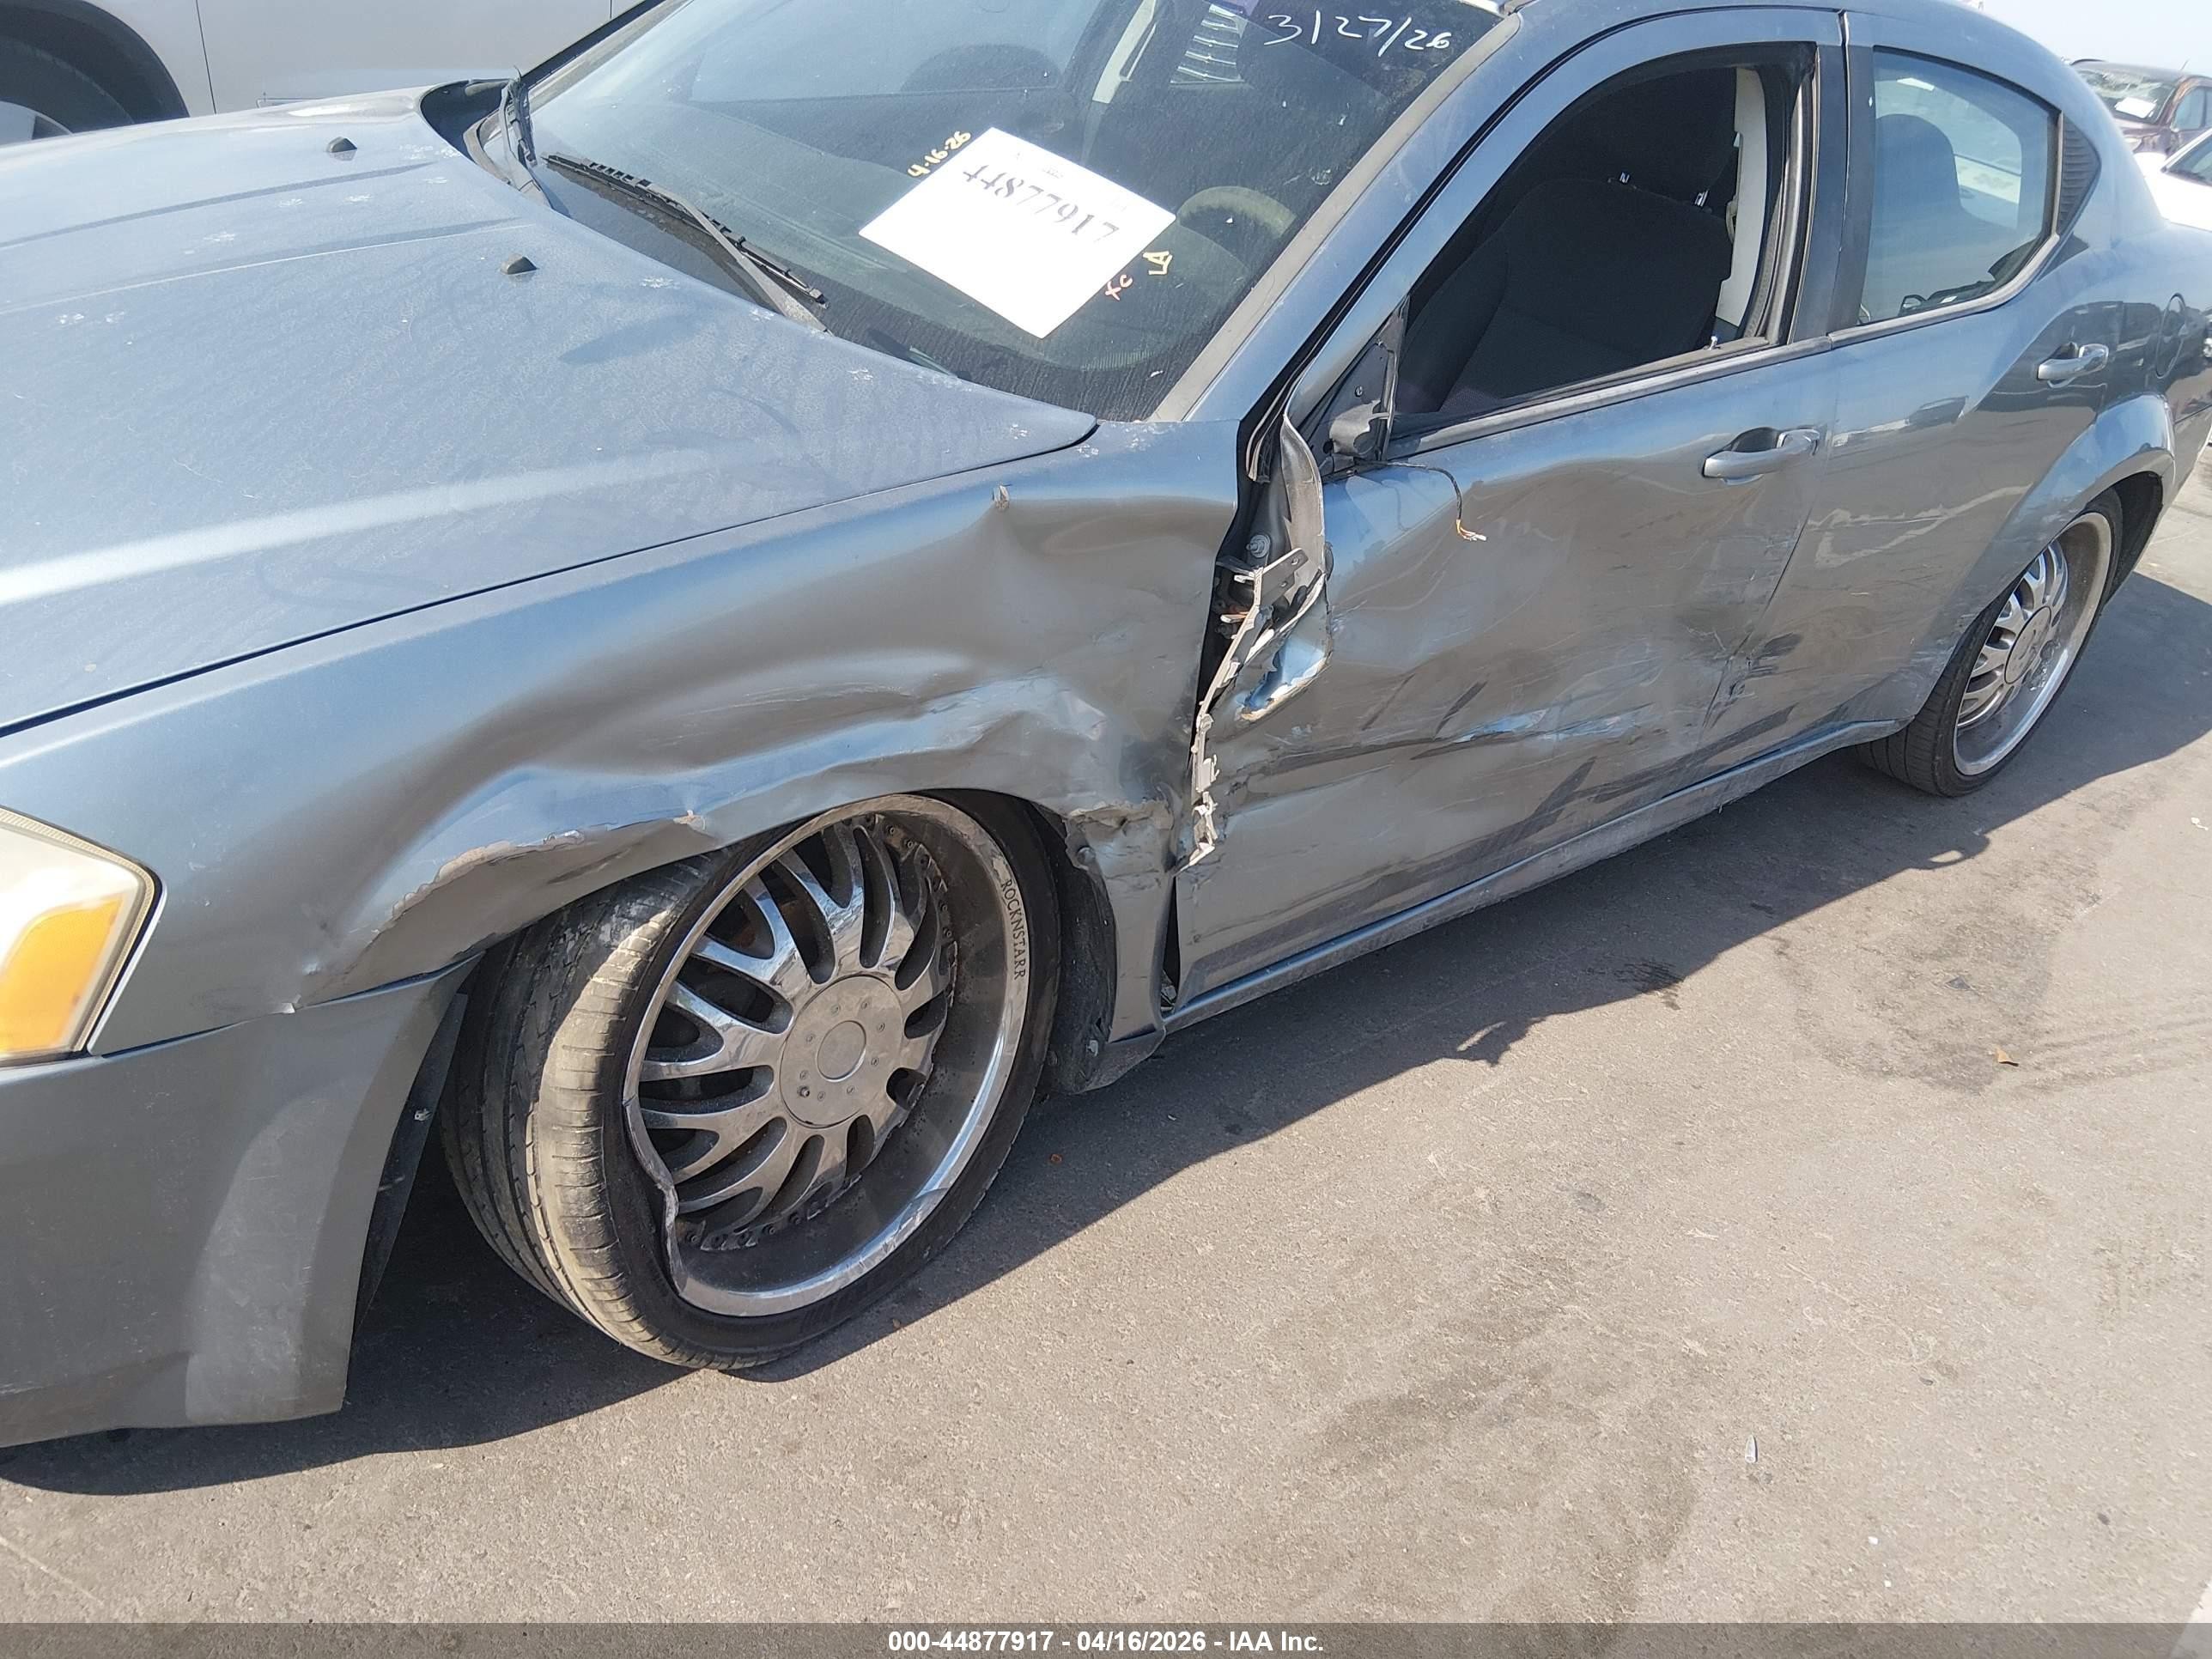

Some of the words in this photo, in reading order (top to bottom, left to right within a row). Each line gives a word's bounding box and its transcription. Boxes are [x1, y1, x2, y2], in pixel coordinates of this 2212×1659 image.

[1264, 9, 1452, 57] 3/27/26
[962, 164, 1120, 243] 44877917
[1000, 878, 1026, 980] ROCKNSTARR
